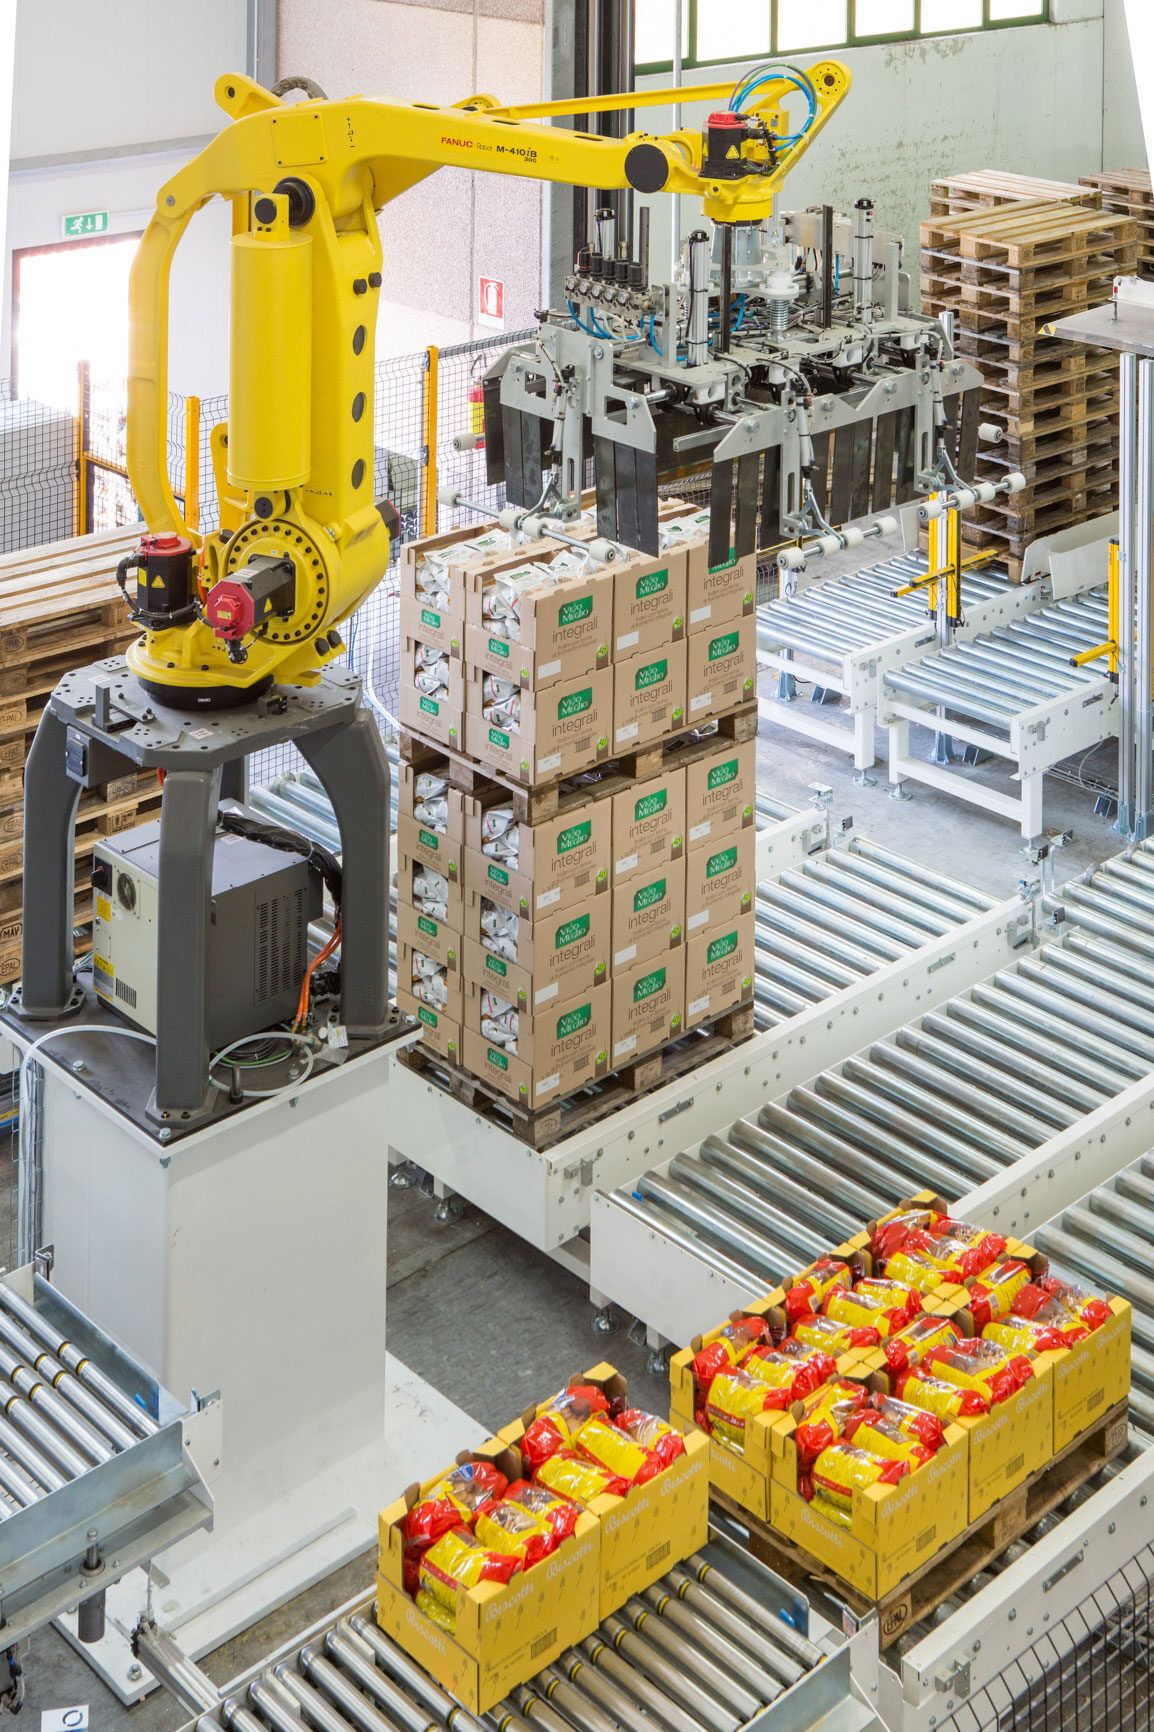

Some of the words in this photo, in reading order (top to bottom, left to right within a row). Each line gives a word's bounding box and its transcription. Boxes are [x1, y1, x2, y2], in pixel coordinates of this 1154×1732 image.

[441, 137, 473, 148] FANUC
[477, 142, 493, 151] Robot
[704, 566, 744, 590] integrali
[630, 589, 673, 615] integrali
[552, 617, 598, 643] integrali
[704, 651, 744, 677] integrali
[630, 680, 672, 707] integrali
[552, 709, 598, 737] integrali
[703, 778, 743, 806] integrali
[629, 810, 672, 838] integrali
[551, 840, 597, 871] integrali
[701, 866, 742, 895] integrali
[628, 899, 671, 930] integrali
[549, 935, 595, 967] integrali
[702, 949, 743, 980] integrali
[628, 988, 671, 1020] integrali
[551, 1023, 597, 1057] integrali
[1096, 1321, 1127, 1350] Biscotti
[1057, 1350, 1090, 1383] Biscotti
[1016, 1382, 1049, 1414] Biscotti
[973, 1414, 1009, 1445] Biscotti
[660, 1460, 703, 1497] Biscotti
[927, 1452, 962, 1484] Biscotti
[605, 1497, 650, 1534] Biscotti
[882, 1482, 919, 1519] Biscotti
[800, 1507, 843, 1548] Biscotti
[546, 1541, 594, 1581] Biscotti
[485, 1583, 535, 1622] Biscotti
[406, 1607, 446, 1657] Biscotti
